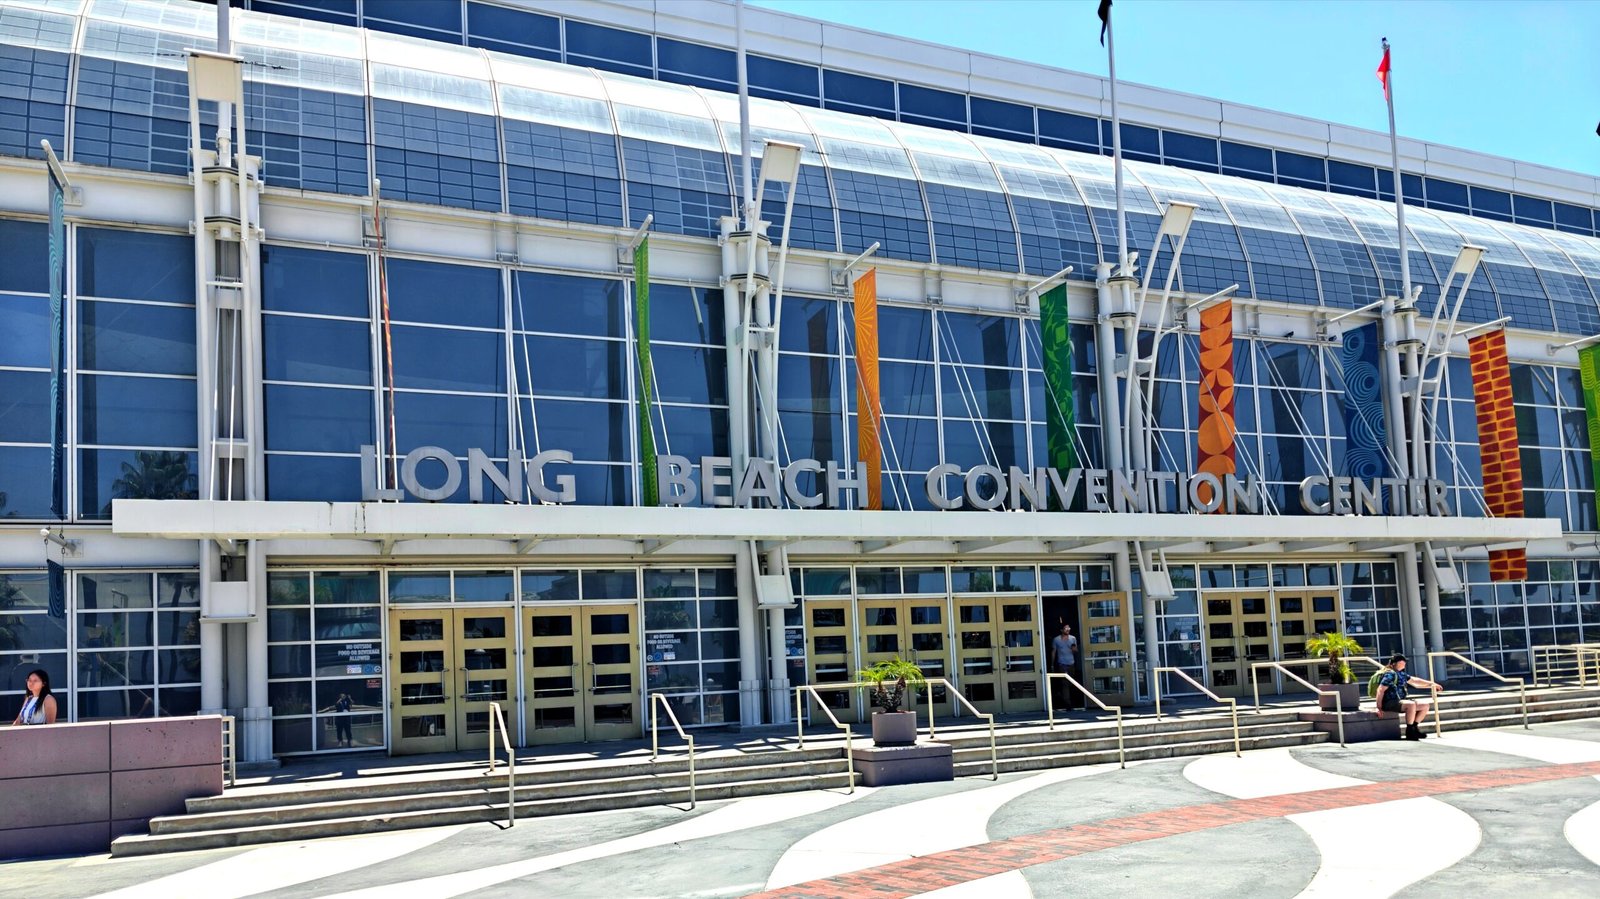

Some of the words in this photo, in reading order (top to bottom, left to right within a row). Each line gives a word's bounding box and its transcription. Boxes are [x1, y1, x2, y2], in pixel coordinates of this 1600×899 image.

[361, 445, 576, 502] LONG
[657, 454, 868, 508] BEACH
[926, 464, 1258, 513] CONVENTION
[1300, 475, 1452, 516] CENTER
